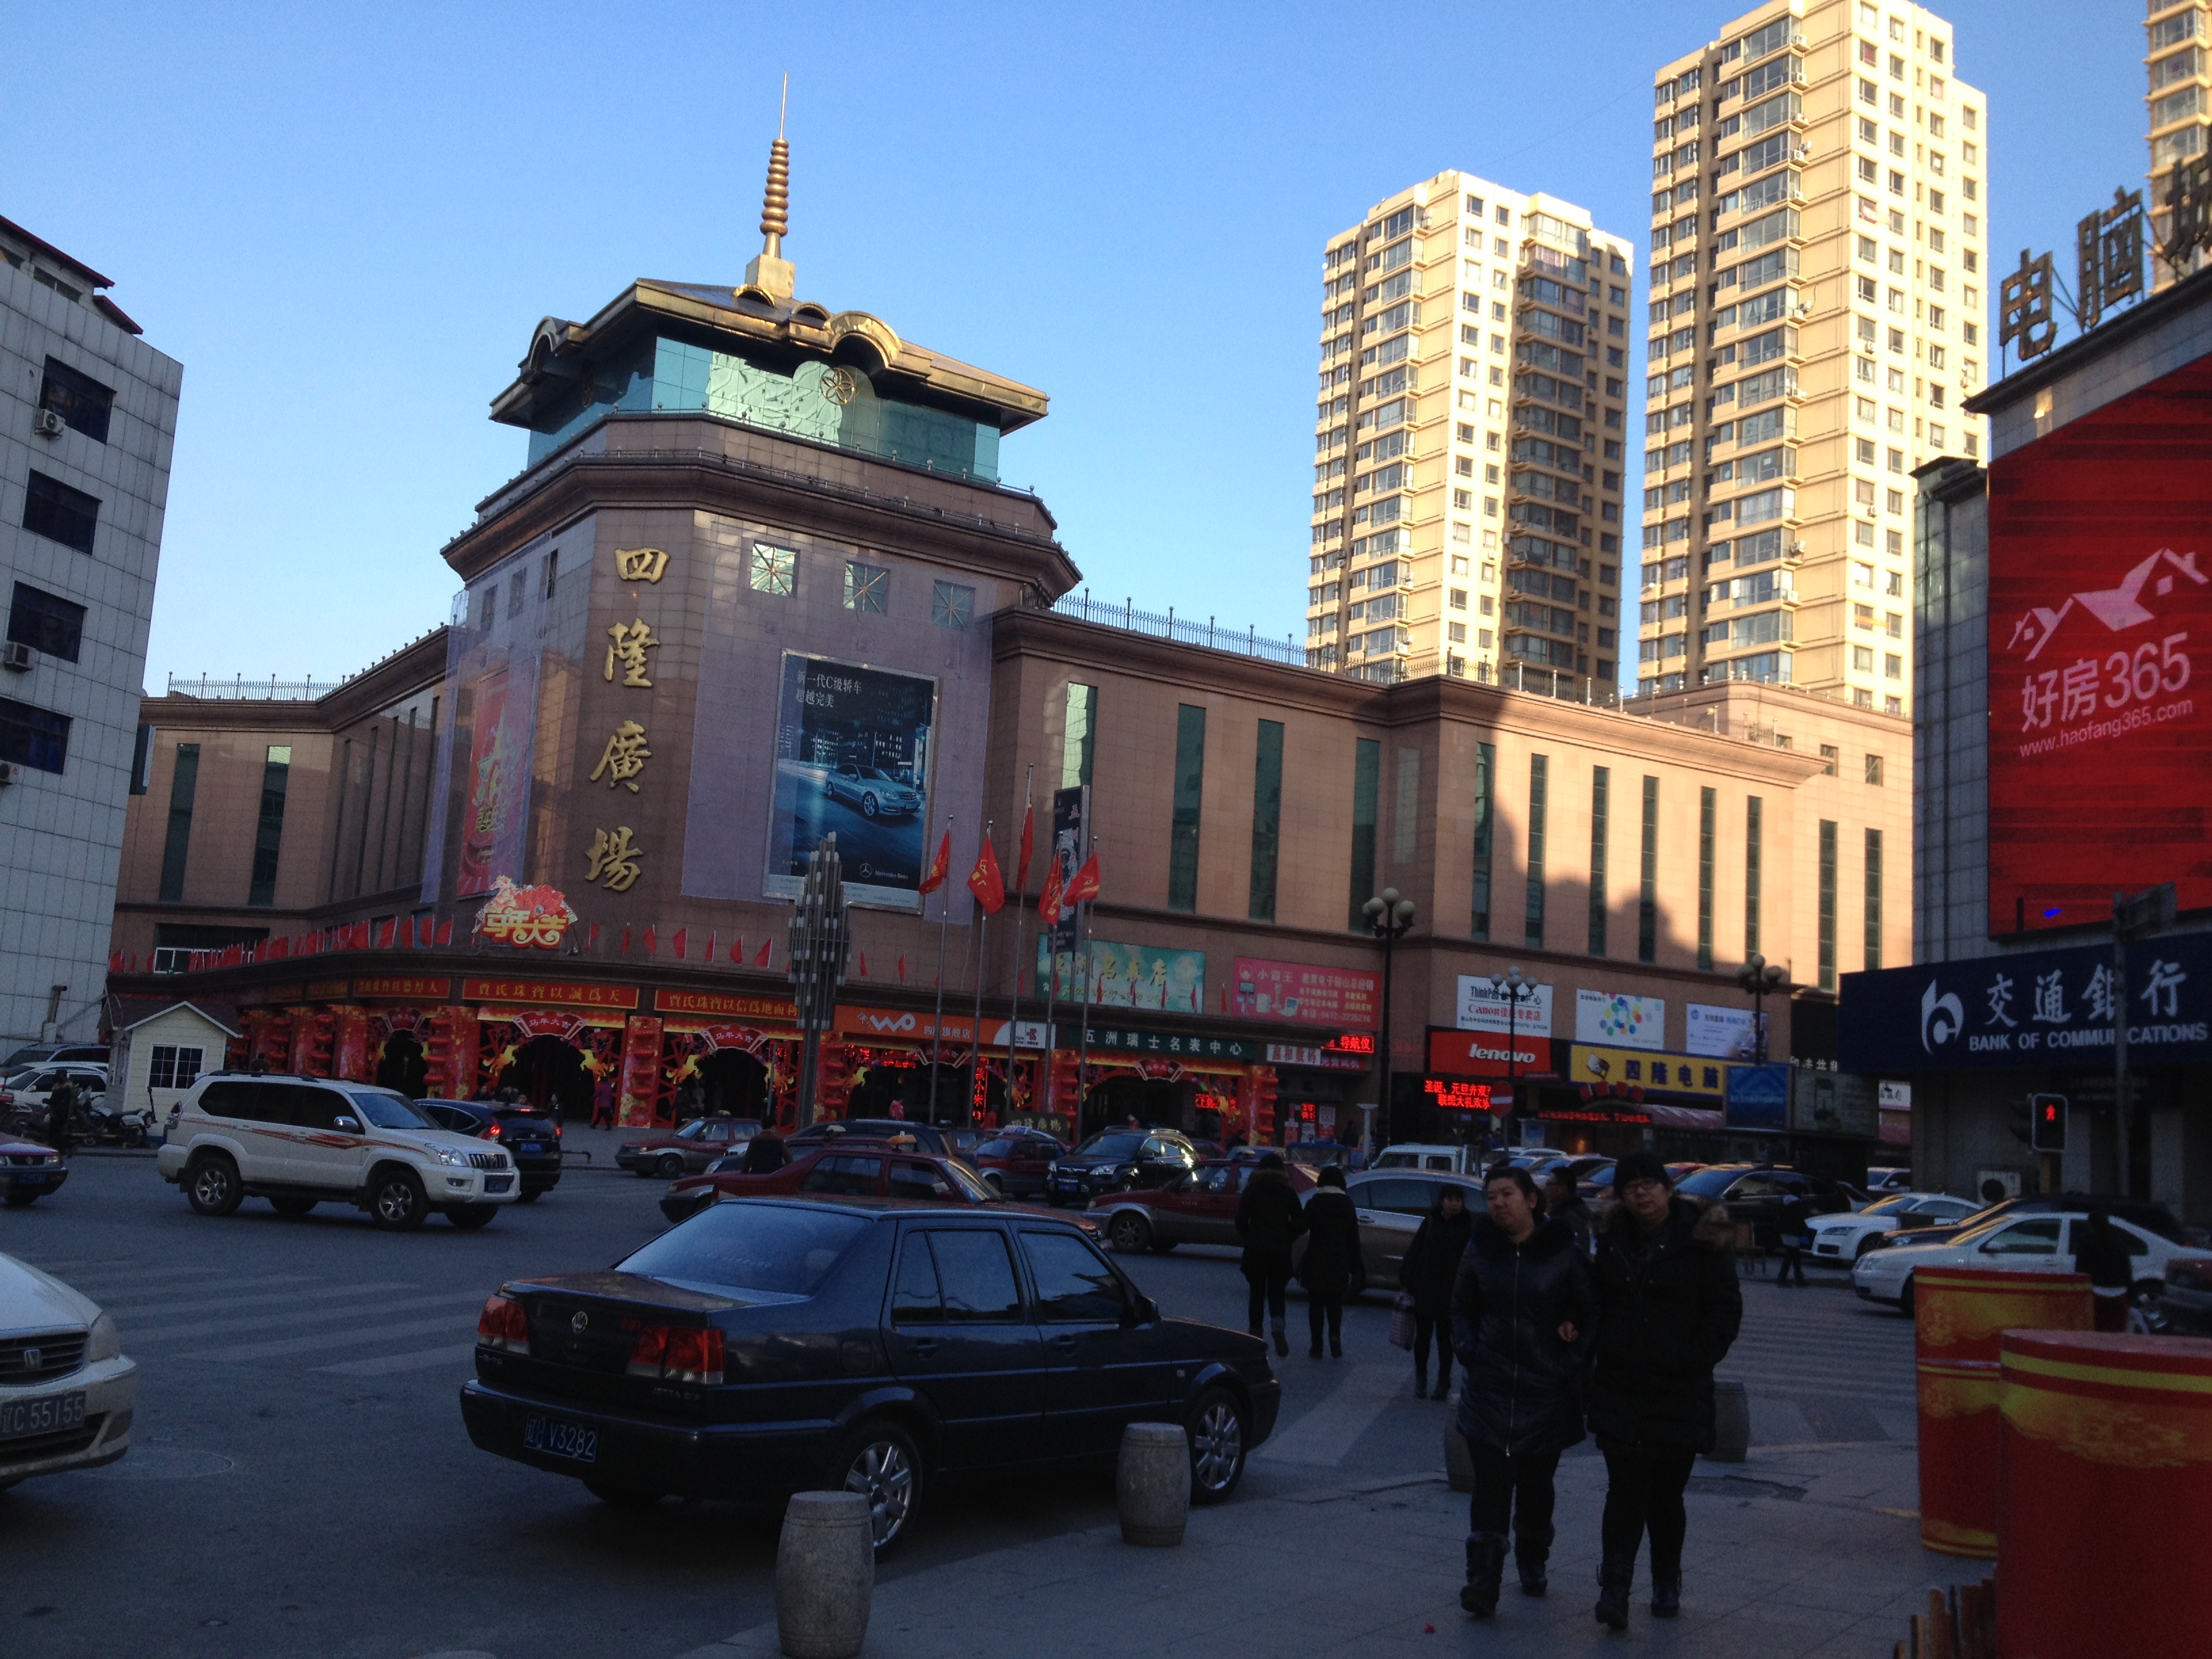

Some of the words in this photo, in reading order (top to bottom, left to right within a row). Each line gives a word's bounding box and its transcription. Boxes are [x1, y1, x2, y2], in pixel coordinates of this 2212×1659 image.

[796, 669, 862, 695] 新一代C级轿车
[2022, 631, 2191, 733] 好房365
[795, 688, 834, 708] 超越完美
[2020, 699, 2193, 757] www.haofang365.com
[483, 907, 567, 946] 马年大吉
[1085, 1029, 1242, 1056] 五洲瑞士名表中心
[1969, 1034, 2011, 1051] BANK
[2018, 1033, 2040, 1049] OF
[2047, 1023, 2209, 1048] COMMUCATIONS
[1469, 1043, 1536, 1063] lenovo
